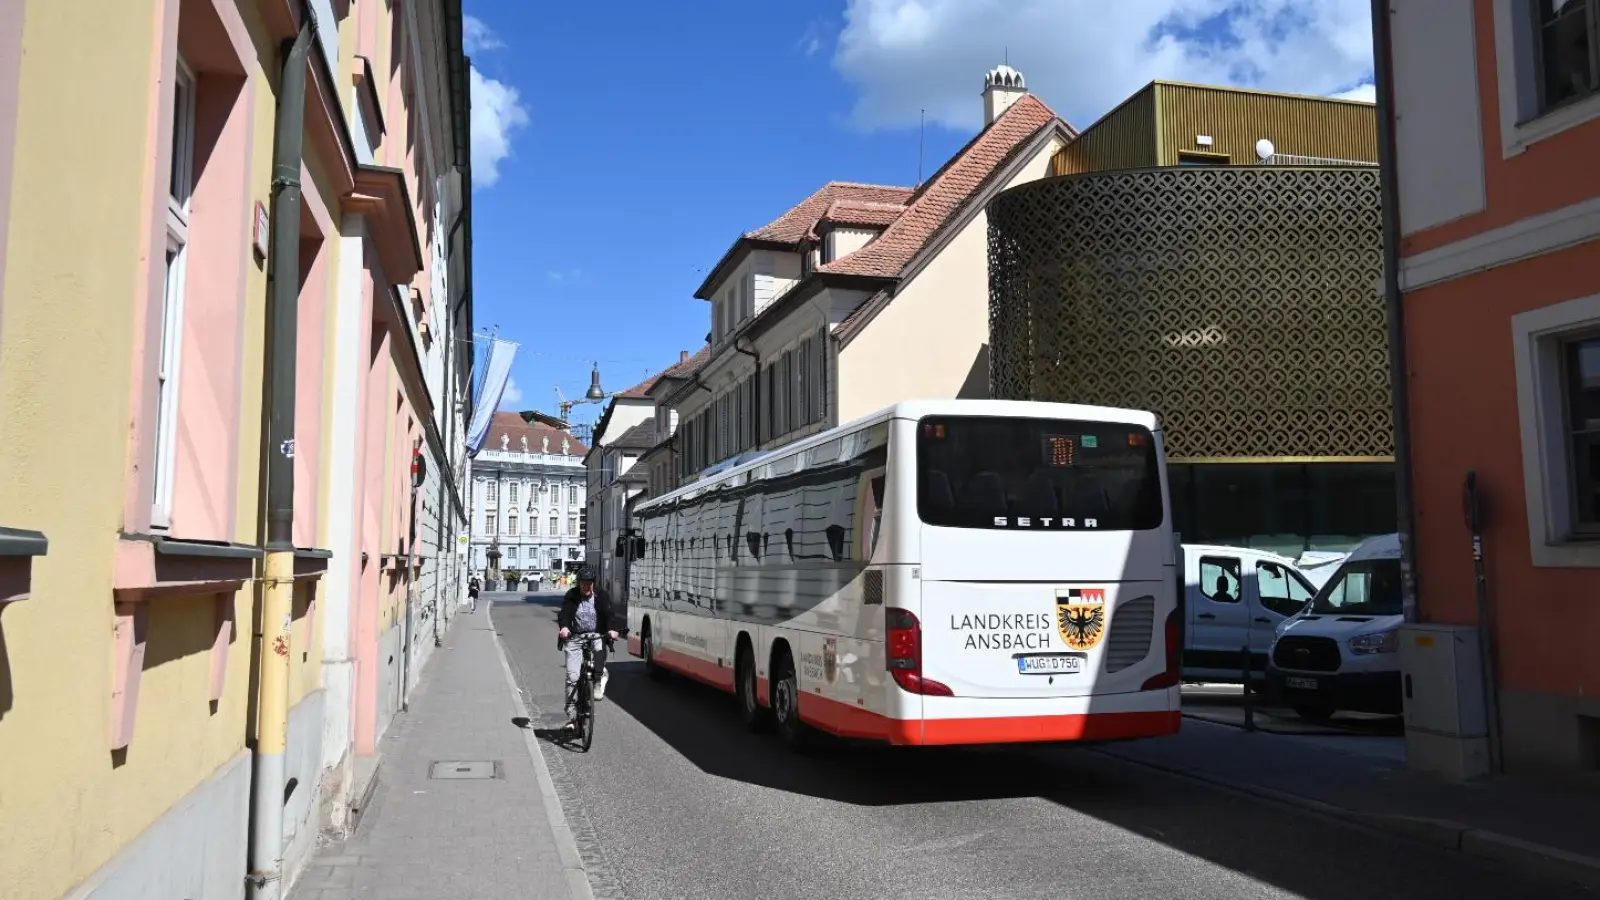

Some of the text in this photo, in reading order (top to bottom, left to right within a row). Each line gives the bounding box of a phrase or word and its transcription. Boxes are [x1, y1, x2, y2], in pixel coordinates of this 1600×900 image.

[994, 516, 1098, 528] SETRA
[951, 613, 1050, 630] LANDKREIS
[964, 632, 1050, 650] ANSBACH
[1025, 658, 1046, 669] WUG
[1052, 658, 1058, 669] D
